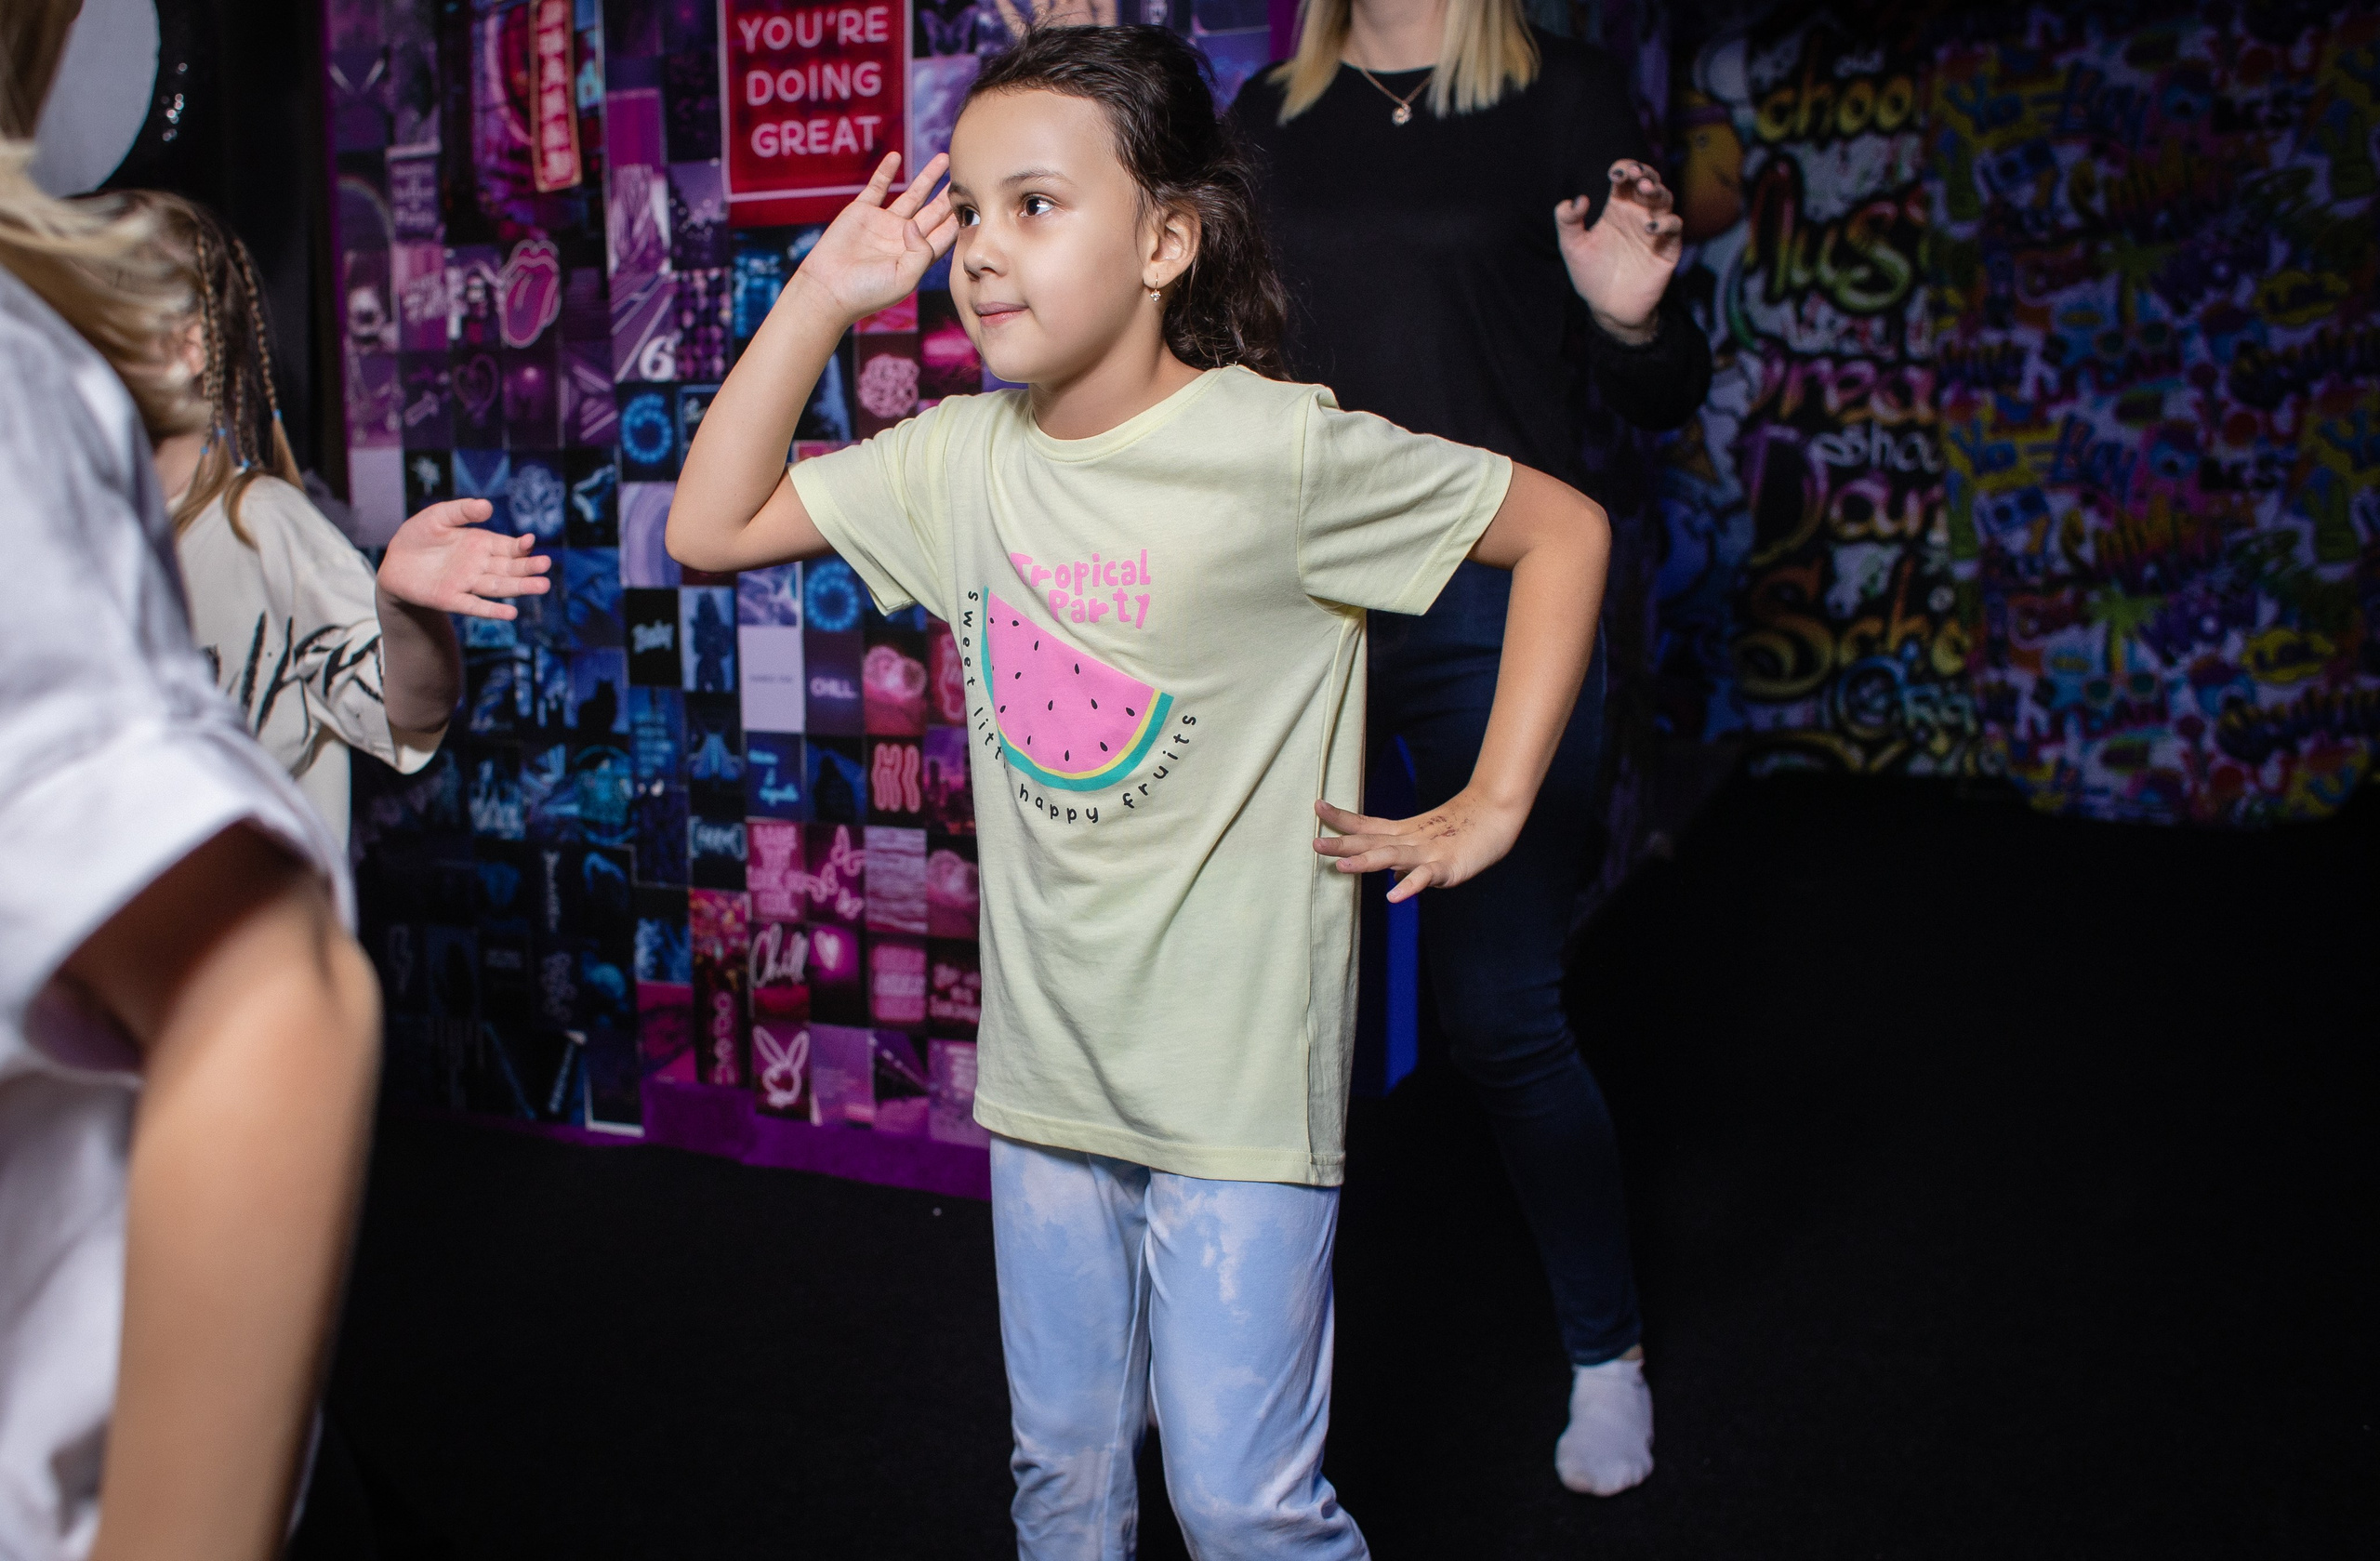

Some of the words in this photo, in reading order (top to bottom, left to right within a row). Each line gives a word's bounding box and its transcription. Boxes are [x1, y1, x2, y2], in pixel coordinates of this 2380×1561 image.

[737, 6, 889, 54] YOU'RE
[746, 61, 882, 106] DOING
[750, 115, 882, 158] GREAT
[1010, 549, 1151, 596] Tropical
[1049, 588, 1151, 629] Party
[962, 591, 979, 686] sweet
[973, 707, 1006, 770] litt
[1019, 784, 1099, 824] happy
[1122, 714, 1197, 809] fruits
